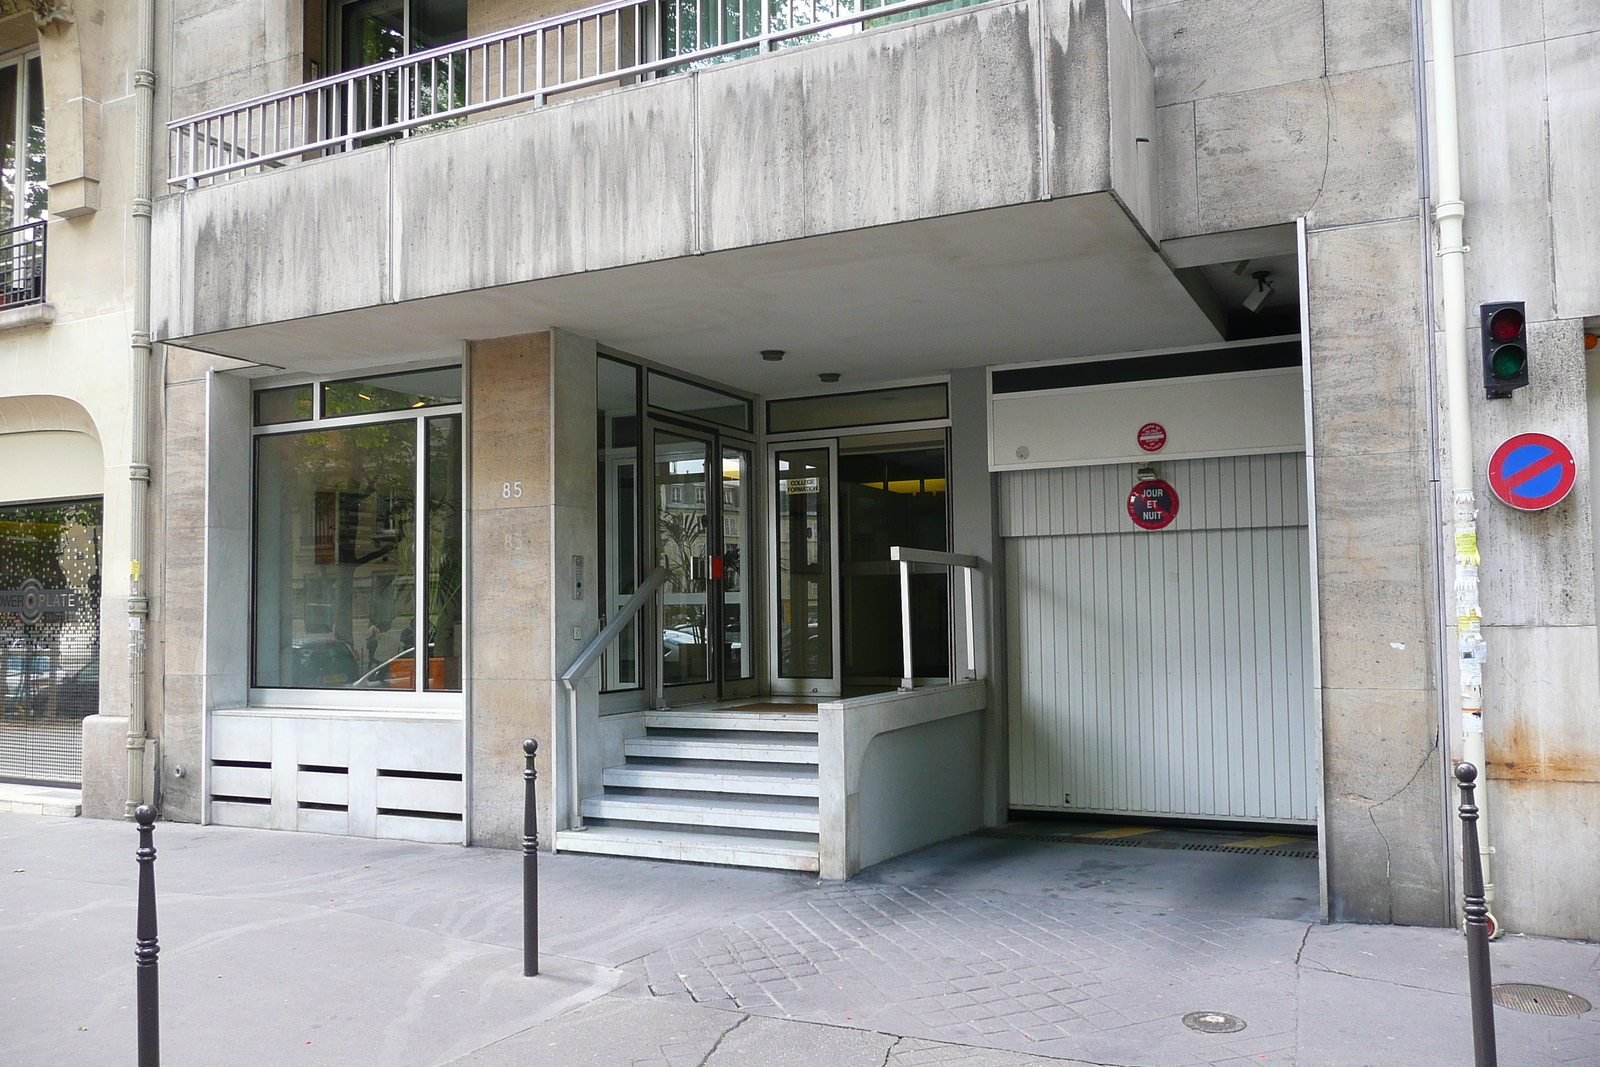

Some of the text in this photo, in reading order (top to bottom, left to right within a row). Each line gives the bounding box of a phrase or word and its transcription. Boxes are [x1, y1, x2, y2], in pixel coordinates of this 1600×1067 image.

[502, 481, 522, 499] 85
[1141, 489, 1163, 498] JOUR
[1146, 500, 1158, 509] ET
[1142, 511, 1162, 520] NUIT
[38, 593, 75, 607] PLATE
